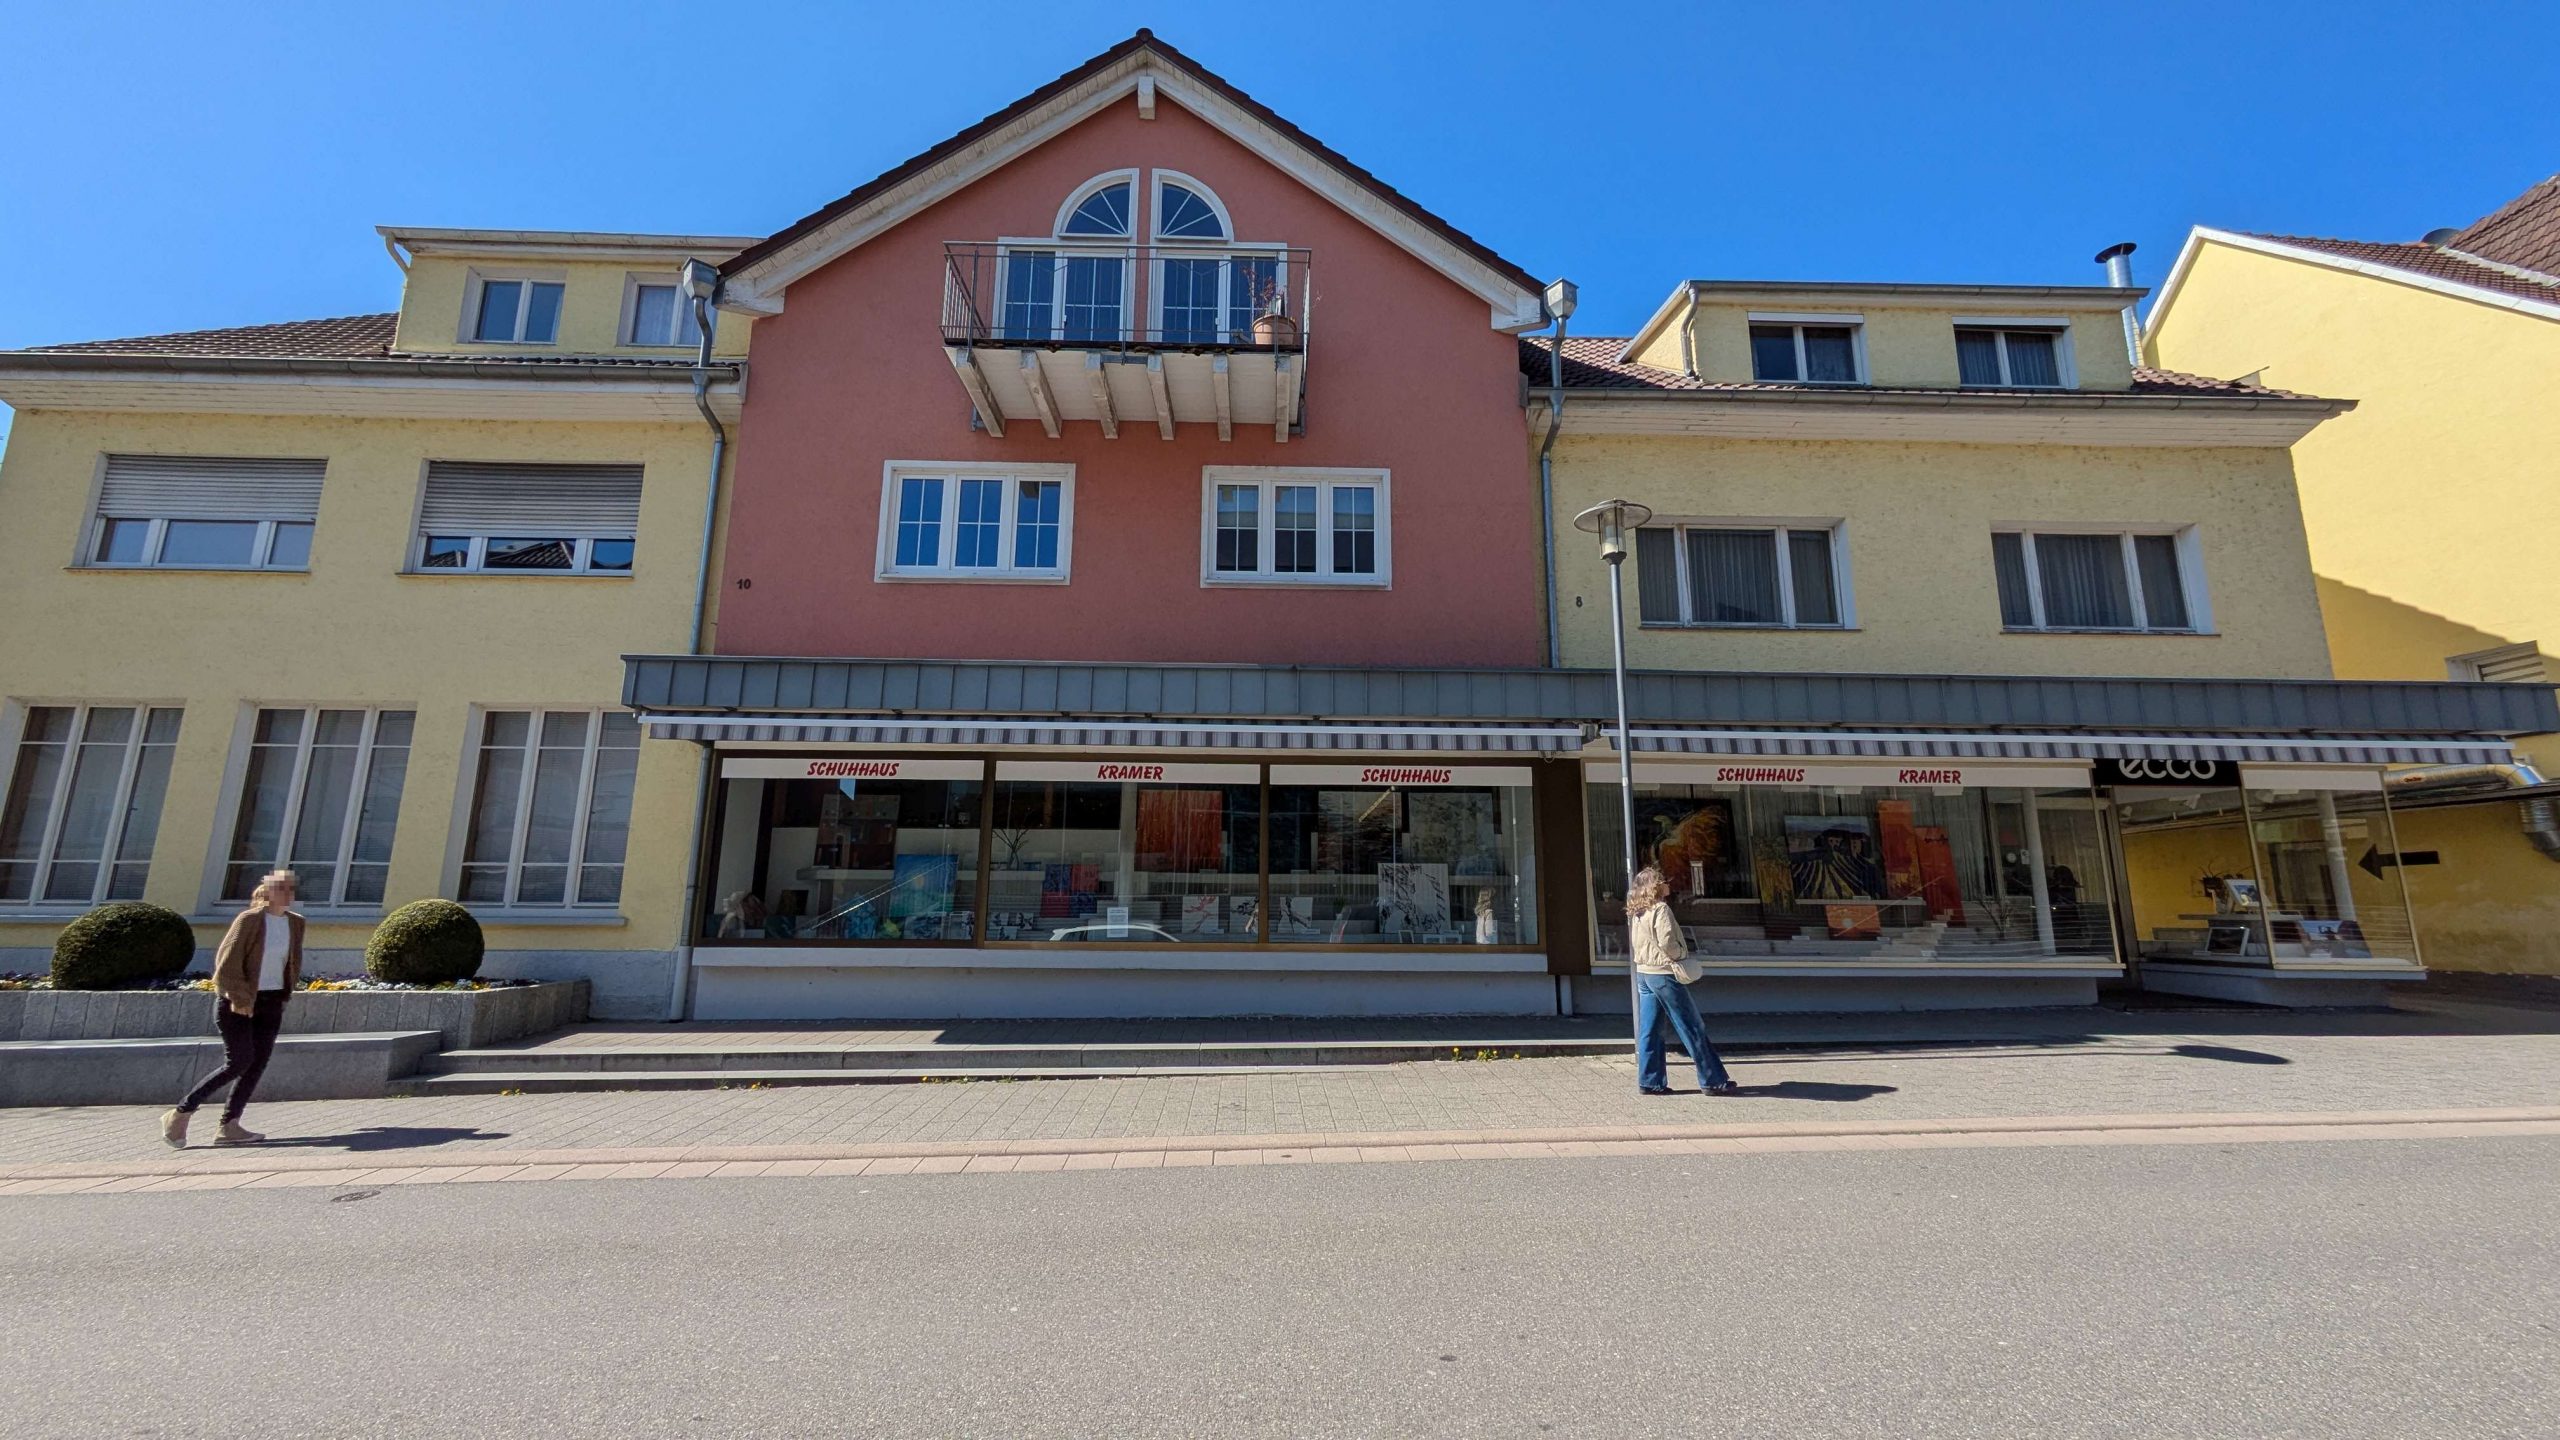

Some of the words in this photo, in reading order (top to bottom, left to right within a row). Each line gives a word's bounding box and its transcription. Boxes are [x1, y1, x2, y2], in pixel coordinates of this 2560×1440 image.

[737, 579, 752, 590] 10
[1575, 595, 1583, 608] 8
[807, 762, 899, 777] SCHUHHAUS
[1097, 765, 1164, 780] KRAMER
[1361, 767, 1452, 783] SCHUHHAUS
[1717, 767, 1805, 782] SCHUHHAUS
[1898, 769, 1962, 784] KRAMER
[2119, 759, 2216, 779] ecco
